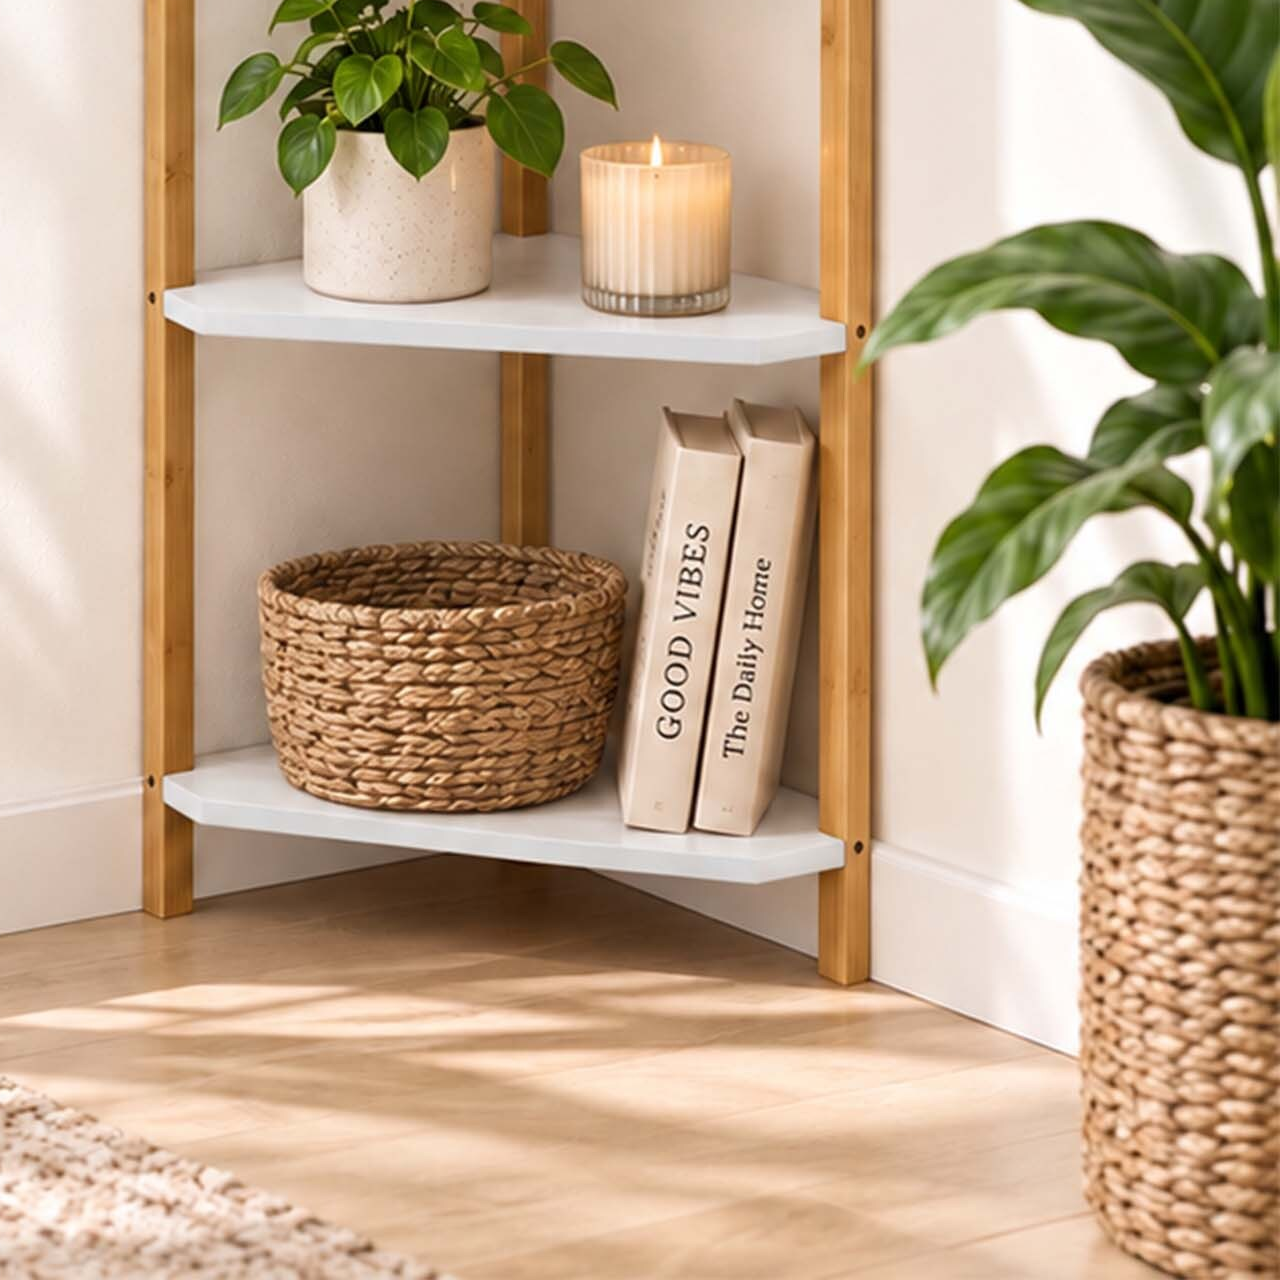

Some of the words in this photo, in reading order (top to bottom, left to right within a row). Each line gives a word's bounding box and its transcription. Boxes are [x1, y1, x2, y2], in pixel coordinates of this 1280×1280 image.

[672, 522, 711, 623] VIBES
[742, 556, 773, 632] Home
[655, 635, 694, 741] GOOD
[731, 638, 766, 704] Daily
[721, 710, 751, 759] The
